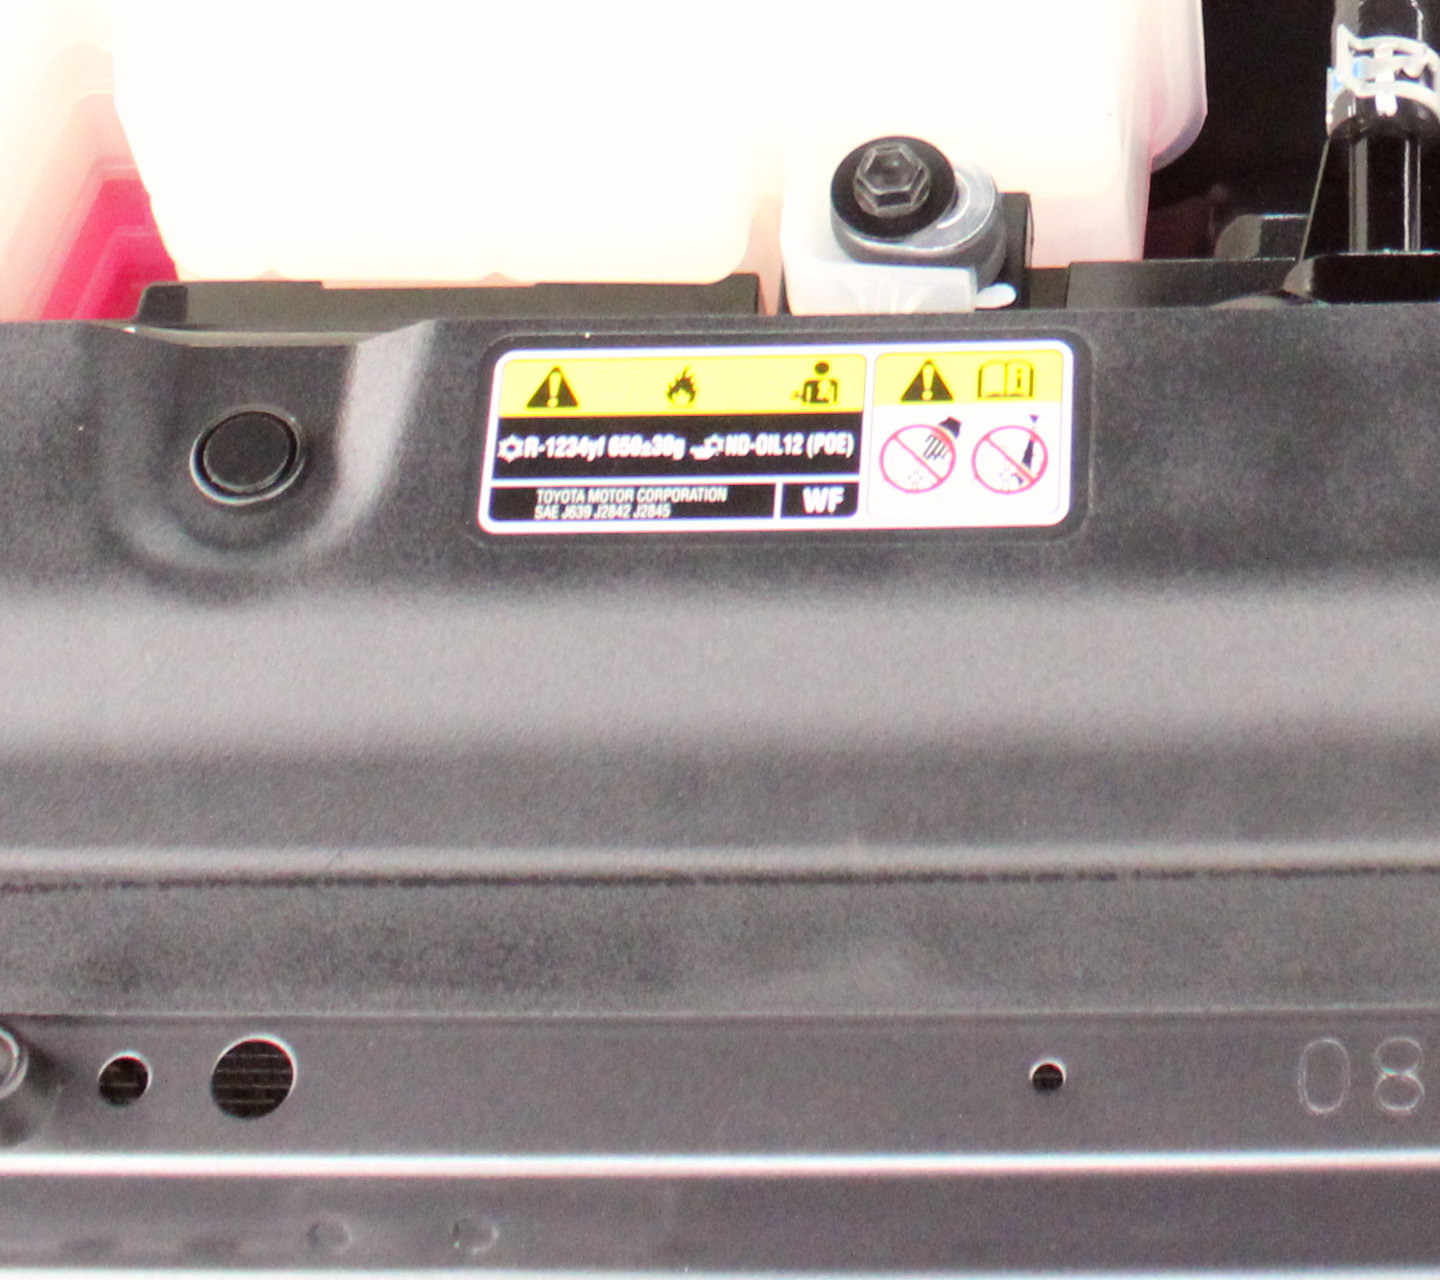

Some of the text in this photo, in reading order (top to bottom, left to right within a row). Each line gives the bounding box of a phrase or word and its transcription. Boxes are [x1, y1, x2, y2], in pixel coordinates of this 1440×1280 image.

[723, 432, 803, 457] ND-OIL12
[806, 432, 855, 460] (POE)
[536, 486, 729, 504] TOYOTA MOTOR CORPORATION
[802, 486, 845, 515] WF
[534, 502, 672, 520] SAE J639 J2842 J2845
